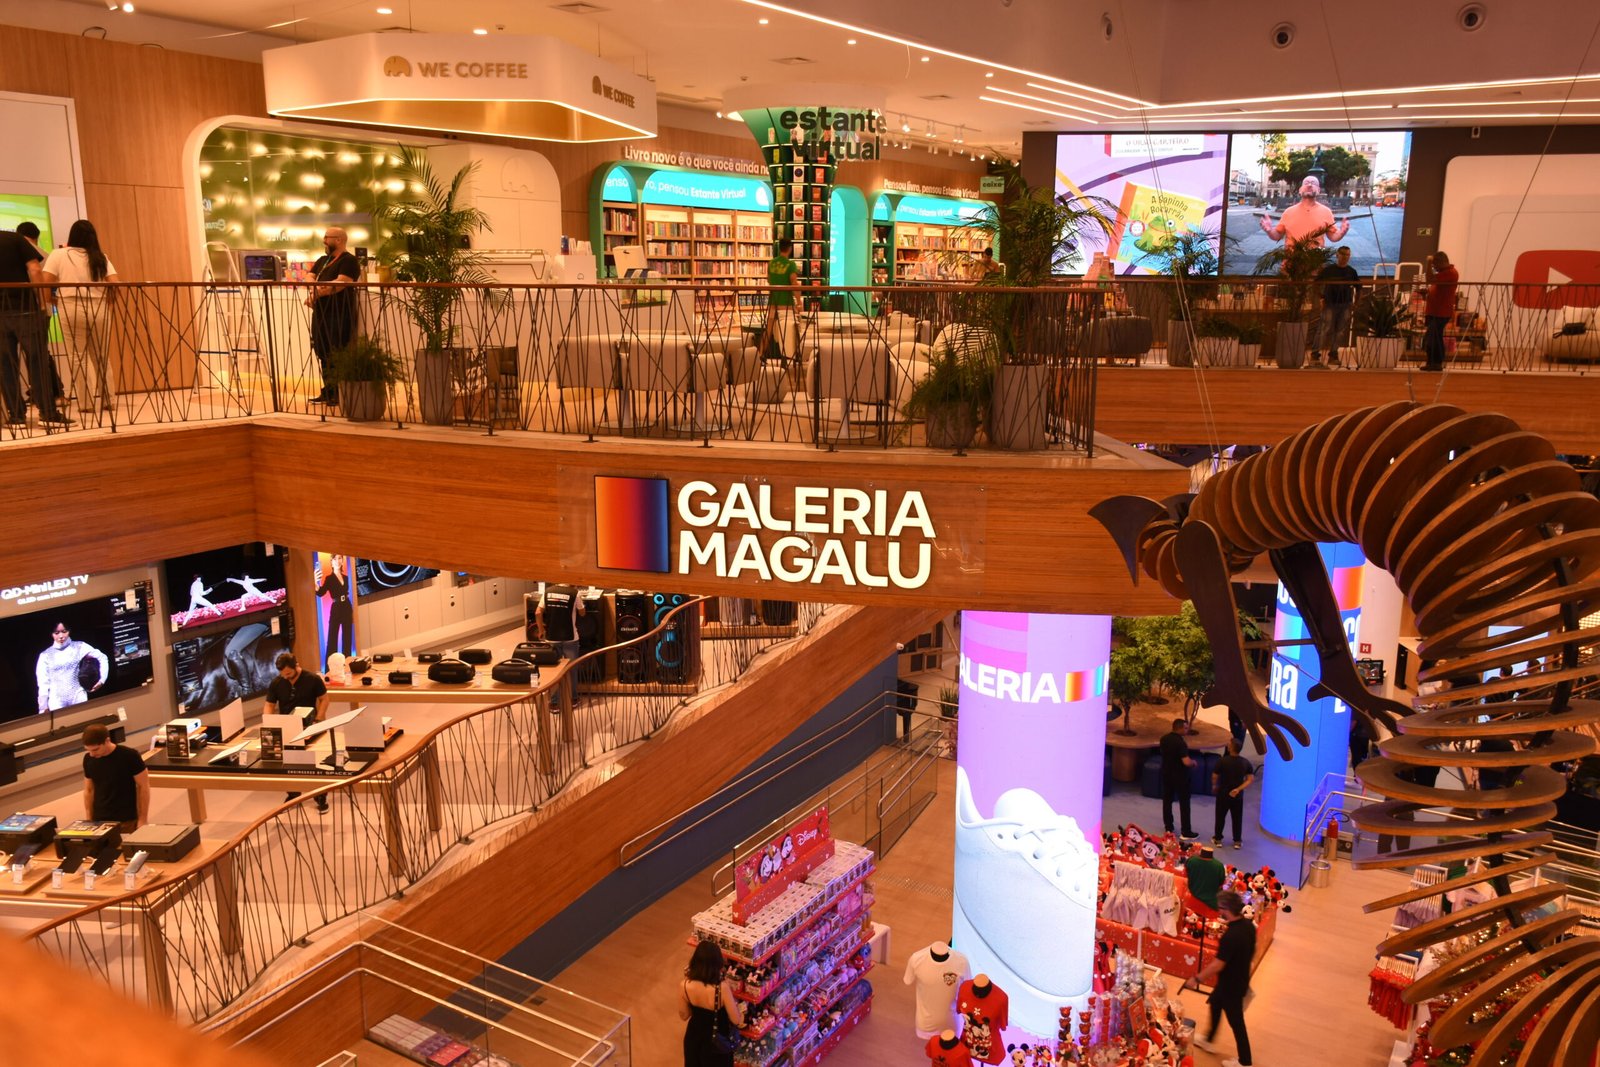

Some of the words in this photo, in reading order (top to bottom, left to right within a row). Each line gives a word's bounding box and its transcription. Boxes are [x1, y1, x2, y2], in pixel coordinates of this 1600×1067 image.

[417, 61, 450, 78] WE
[455, 61, 528, 79] COFFEE
[603, 84, 614, 100] WE
[614, 89, 635, 109] COFFEE
[780, 106, 887, 134] estante
[791, 133, 880, 161] virtual
[624, 146, 650, 161] Livro
[652, 151, 676, 165] novo
[678, 152, 684, 164] é
[686, 157, 692, 167] o
[693, 158, 712, 170] que
[712, 159, 734, 171] você
[735, 161, 759, 175] ainda
[658, 181, 689, 196] pensou
[691, 186, 720, 198] Estante
[721, 187, 746, 198] Virtual
[883, 178, 906, 191] Pensou
[907, 181, 921, 193] livro,
[921, 184, 942, 195] pensou
[962, 188, 979, 199] Virtual
[1151, 195, 1156, 204] A
[677, 480, 936, 539] GALERIA
[678, 530, 932, 589] MAGALU
[47, 578, 71, 590] LED
[71, 574, 89, 586] TV
[795, 828, 819, 846] Disney
